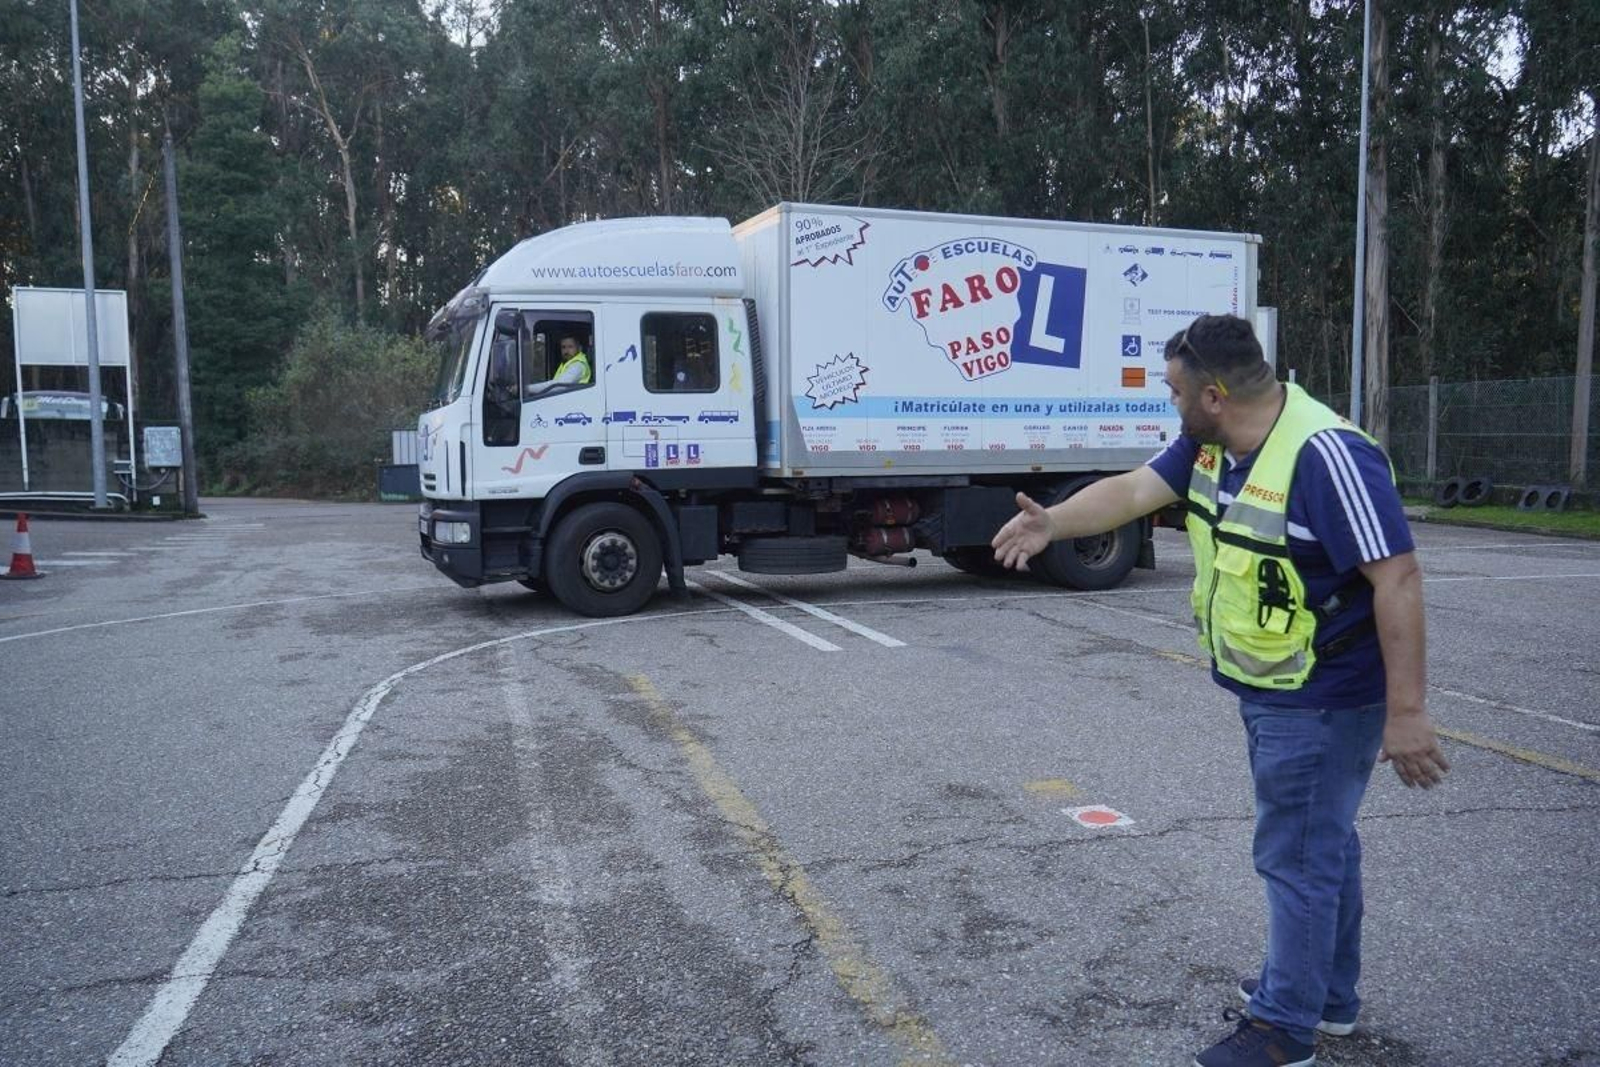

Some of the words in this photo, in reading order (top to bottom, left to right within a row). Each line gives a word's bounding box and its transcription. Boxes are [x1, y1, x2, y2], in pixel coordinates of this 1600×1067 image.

[795, 217, 823, 233] 90%
[795, 225, 842, 245] APROBADOS
[942, 240, 1034, 267] ESCUELAS
[532, 261, 737, 279] www.autoescuelasfaro.com
[911, 266, 1018, 319] FARO
[1029, 273, 1065, 353] L
[948, 327, 1011, 359] PASO
[962, 351, 1009, 378] VIGO
[991, 402, 1008, 413] en
[1014, 402, 1040, 413] una
[1044, 403, 1053, 416] y
[1125, 402, 1167, 414] todas!
